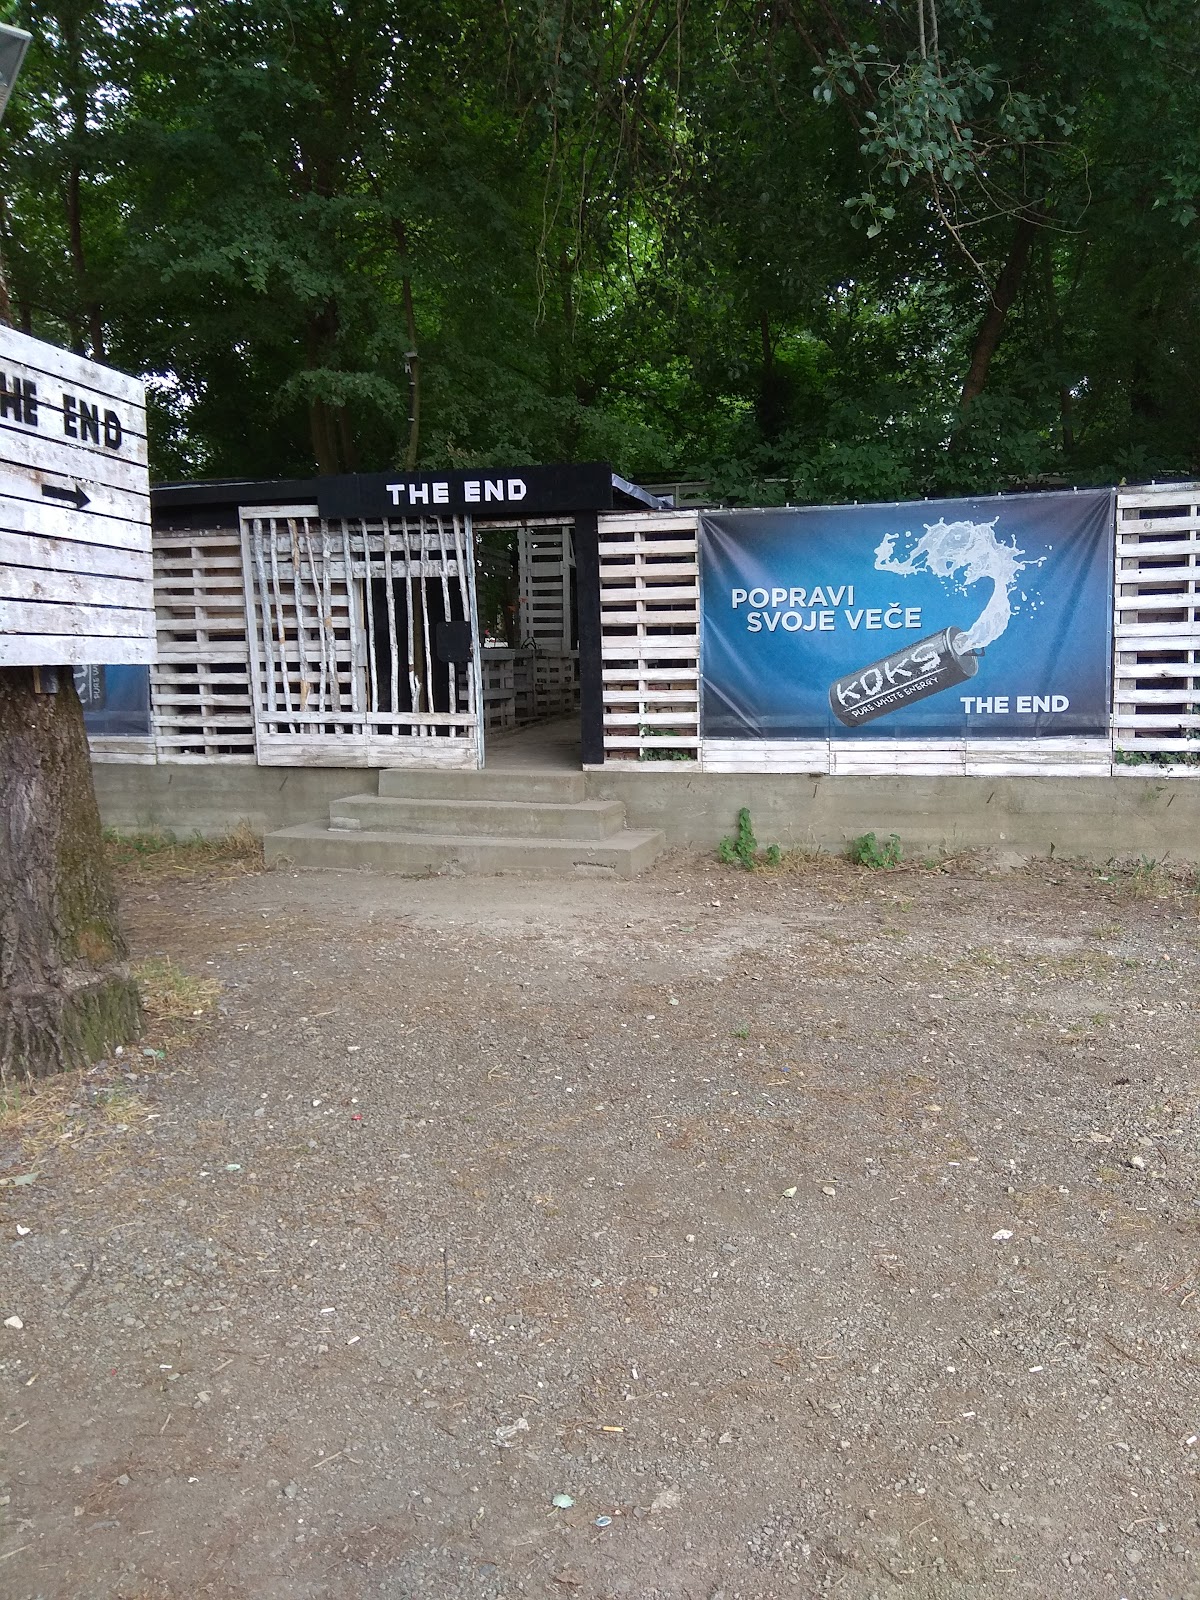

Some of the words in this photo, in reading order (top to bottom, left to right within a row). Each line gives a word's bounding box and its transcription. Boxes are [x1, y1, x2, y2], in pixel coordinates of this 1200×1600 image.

[0, 371, 38, 427] HE
[62, 393, 122, 450] END
[386, 482, 449, 505] THE
[464, 479, 527, 502] END
[732, 585, 854, 609] POPRAVI
[747, 610, 835, 633] SVOJE
[844, 602, 922, 630] VEČE
[836, 643, 942, 707] KOKS
[851, 704, 875, 718] PURE
[873, 692, 905, 709] WHITE
[903, 676, 939, 696] ENERGY
[960, 697, 1009, 714] THE
[1016, 695, 1070, 713] END
